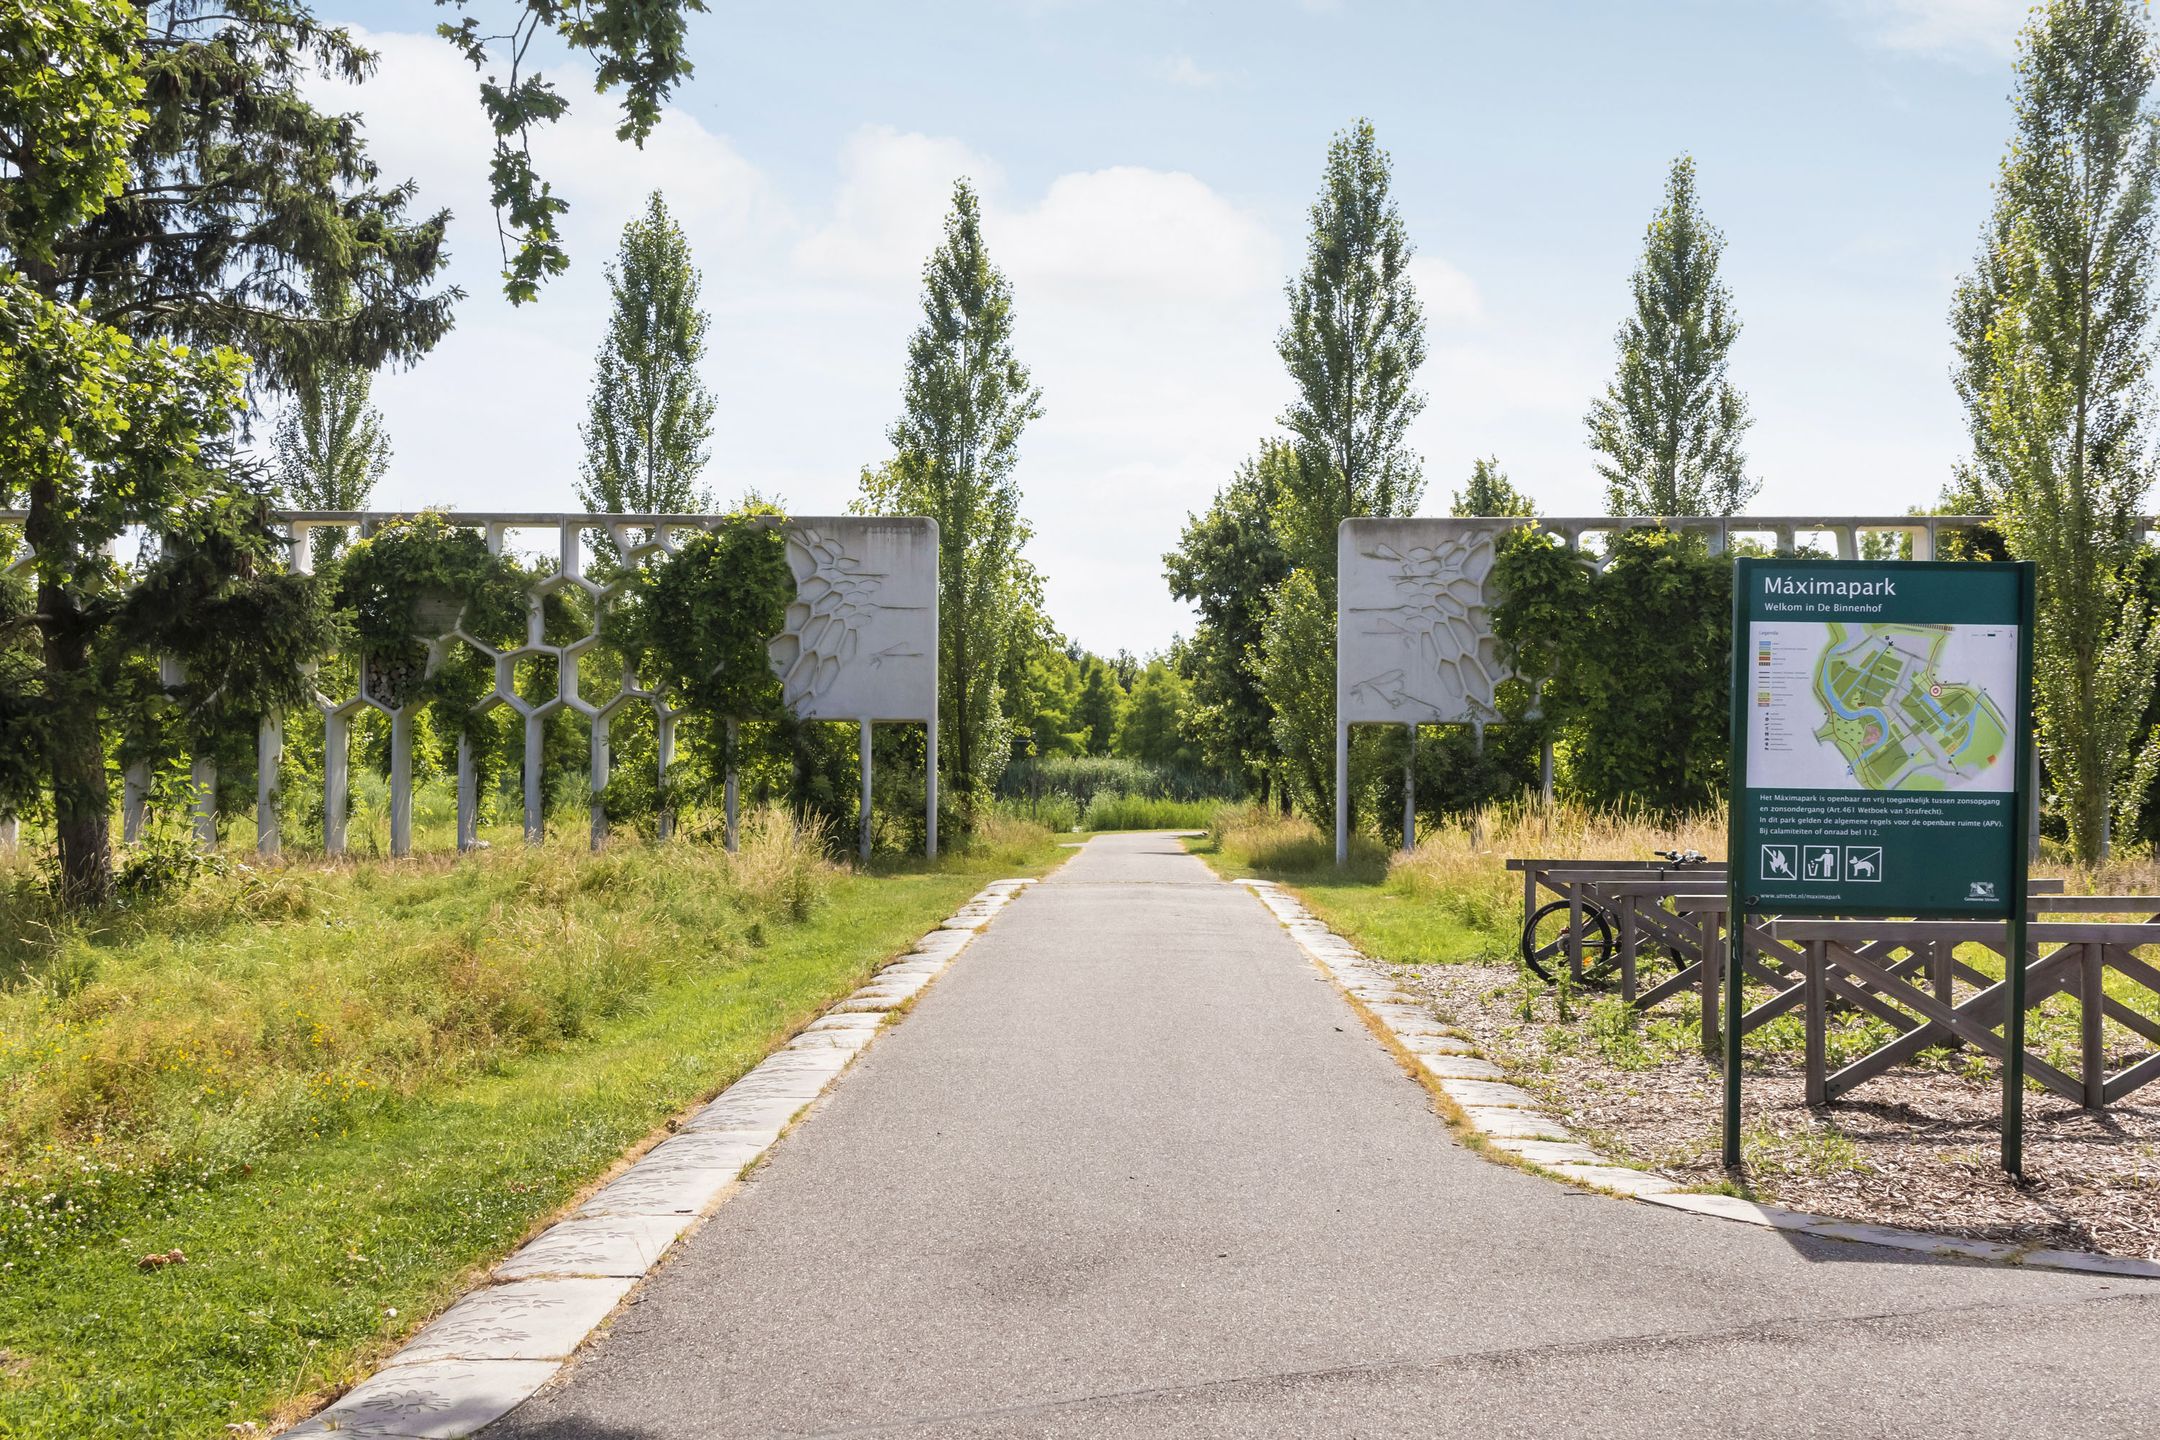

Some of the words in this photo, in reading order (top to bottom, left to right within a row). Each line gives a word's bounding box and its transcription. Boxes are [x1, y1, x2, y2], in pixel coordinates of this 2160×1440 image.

[1764, 576, 1896, 599] Máximapark
[1764, 603, 1802, 611] Welkom
[1805, 603, 1814, 611] in
[1818, 603, 1830, 612] De
[1833, 603, 1882, 612] Binnenhof
[1873, 796, 1884, 804] vrij
[1887, 797, 1930, 805] toegankelijk
[1770, 806, 1825, 814] zonsondergang
[1827, 806, 1855, 814] (Art.461
[1870, 818, 1892, 826] regels
[1982, 820, 2004, 828] (APV).
